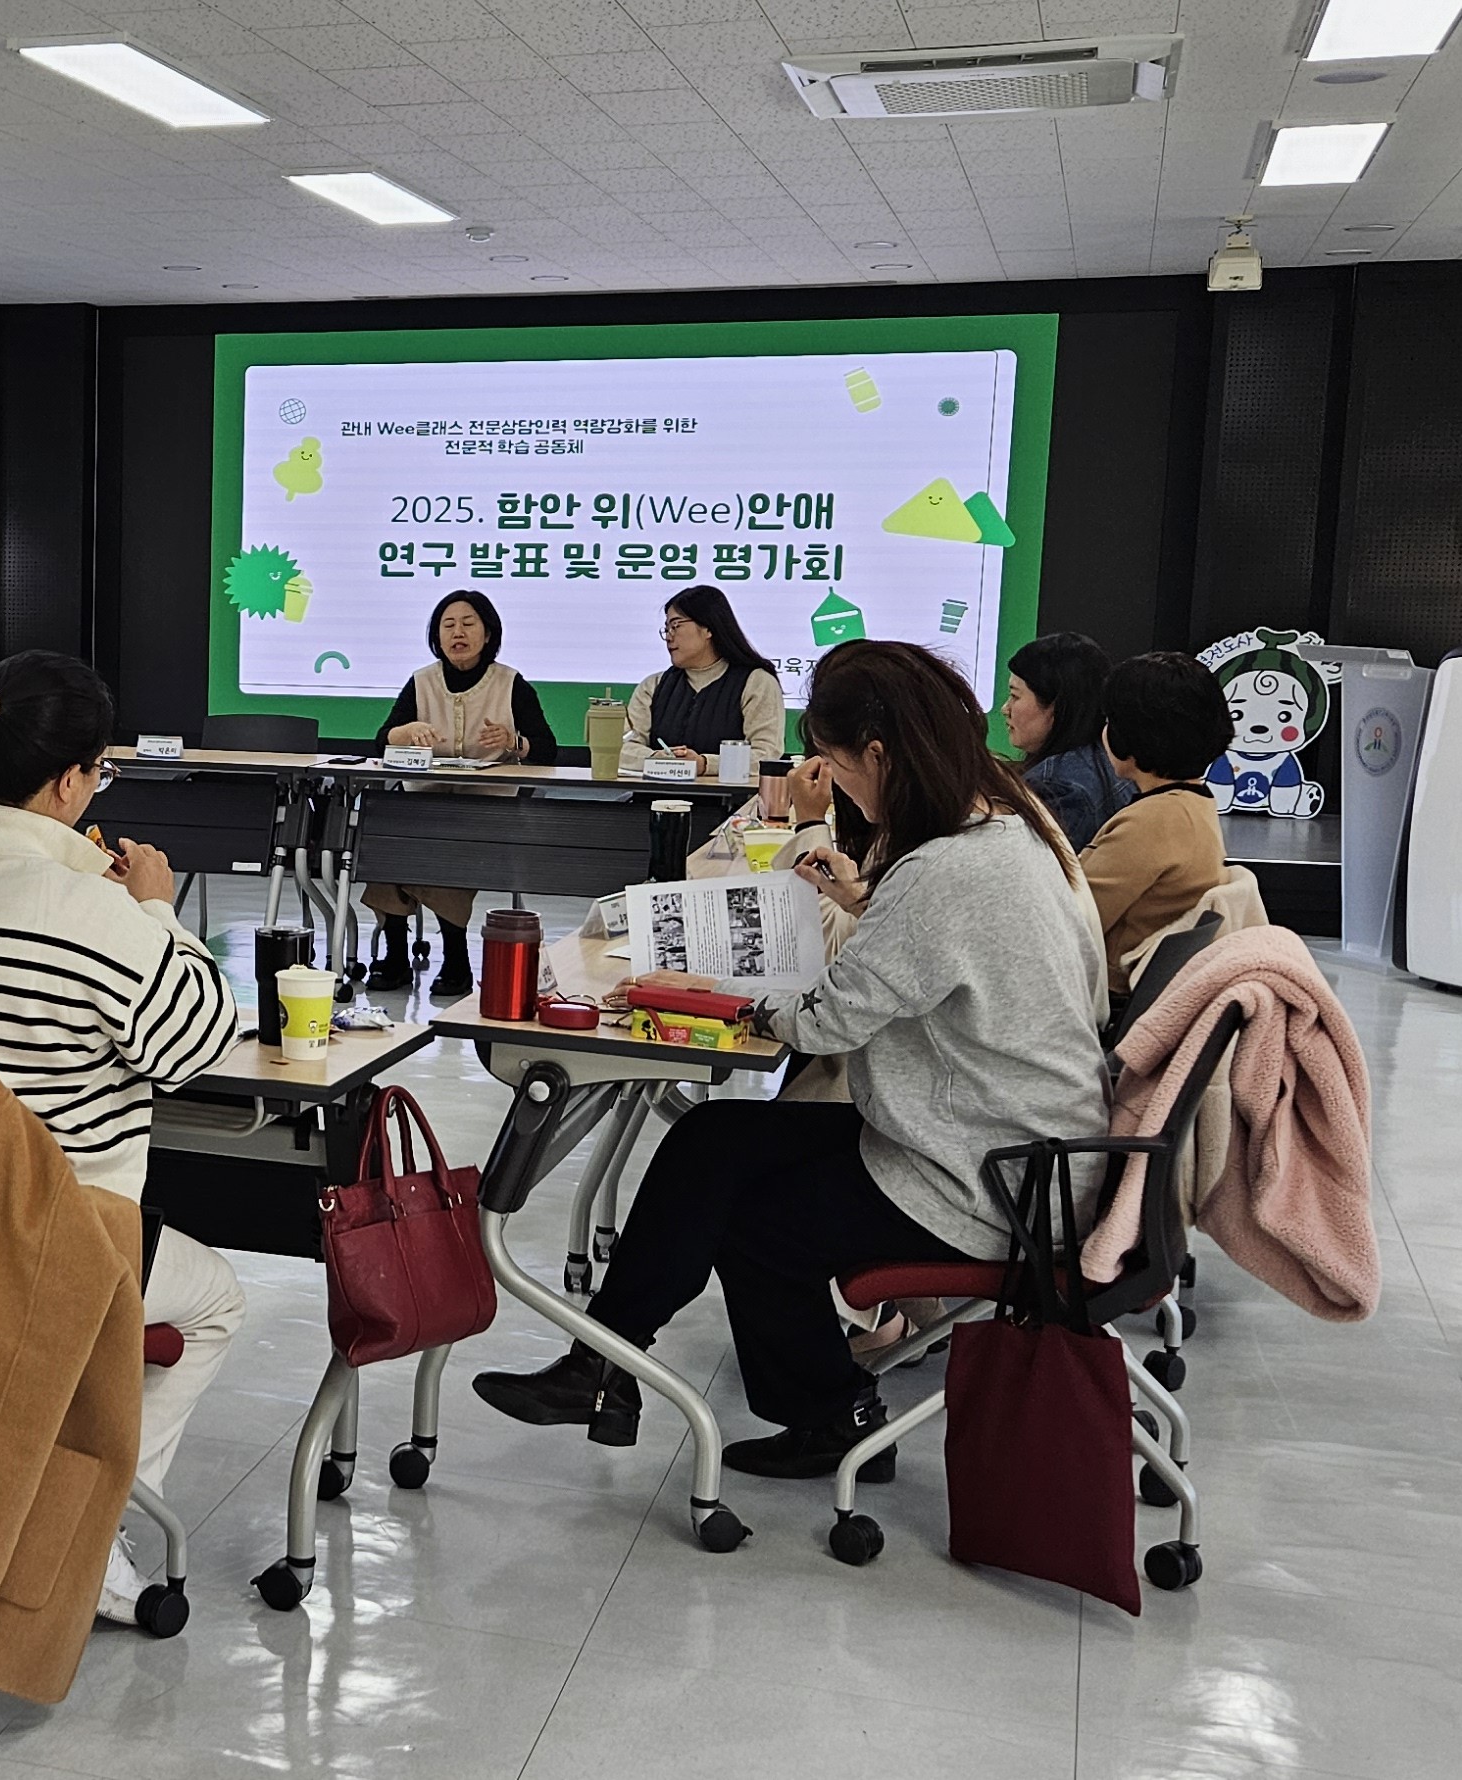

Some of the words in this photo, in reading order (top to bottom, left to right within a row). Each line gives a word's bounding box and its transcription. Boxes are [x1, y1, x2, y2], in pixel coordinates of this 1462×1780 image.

[341, 421, 372, 437] 관내
[376, 420, 464, 437] Wee클래스
[468, 419, 567, 436] 전문상담인력
[573, 418, 658, 435] 역량강화를
[662, 417, 698, 434] 위한
[445, 439, 493, 455] 전문적
[497, 439, 530, 455] 학습
[534, 438, 584, 455] 공동체
[390, 495, 484, 524] 2025.
[496, 492, 582, 530] 함안
[590, 492, 835, 531] 위(Wee)안애
[378, 541, 457, 578] 연구
[469, 542, 550, 579] 발표
[563, 542, 601, 580] 및
[614, 543, 698, 581] 운영
[712, 543, 844, 582] 평가회
